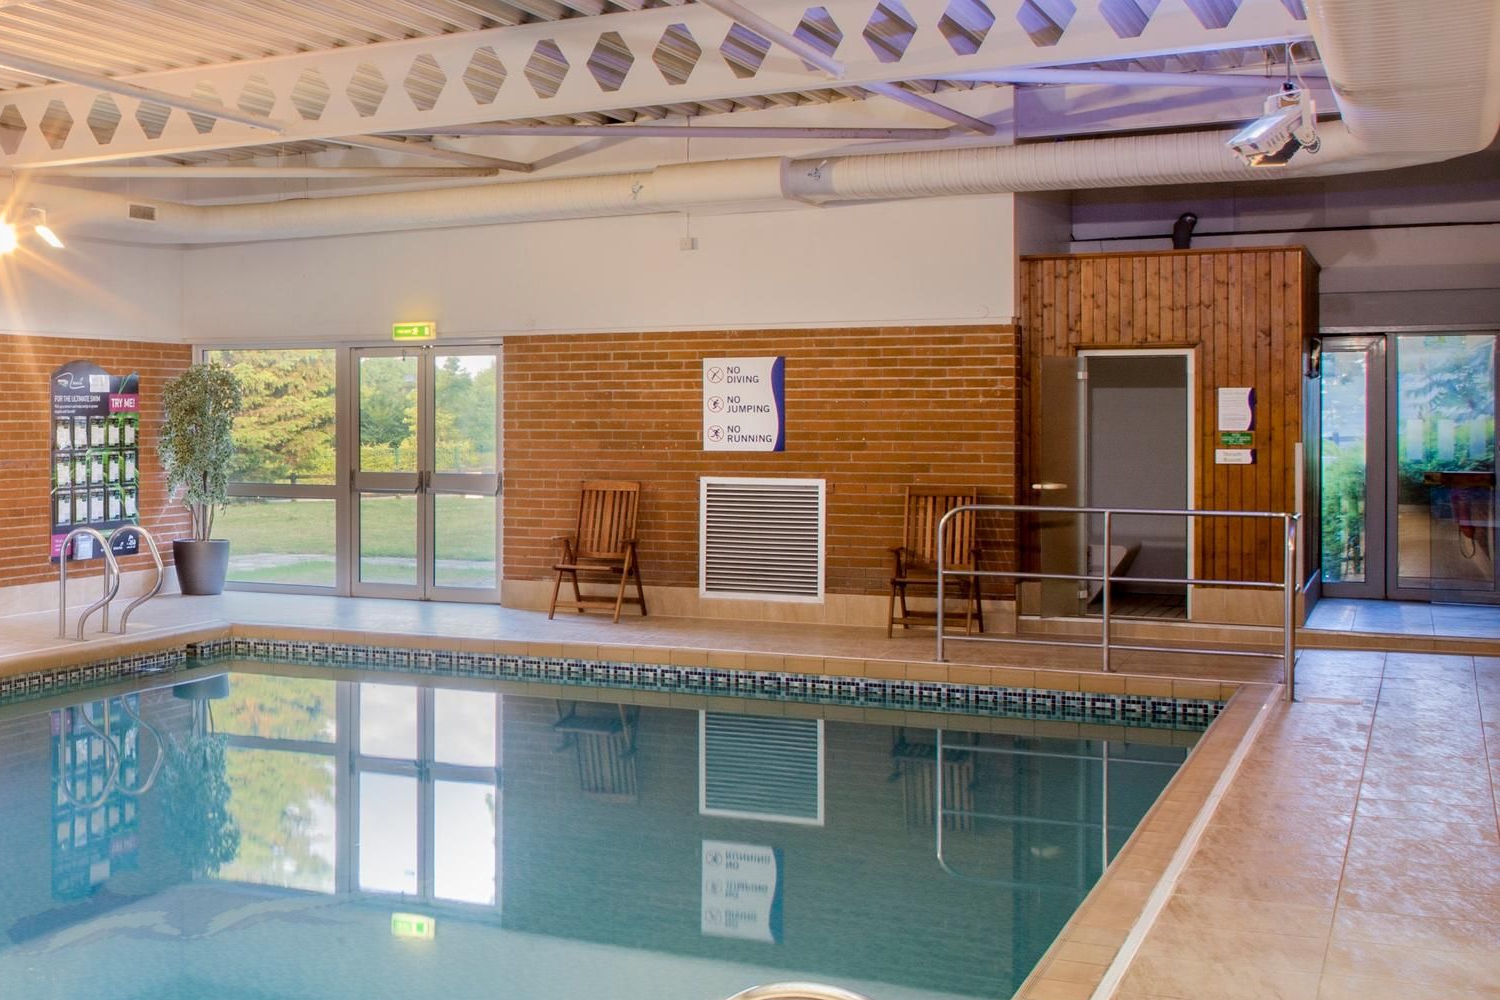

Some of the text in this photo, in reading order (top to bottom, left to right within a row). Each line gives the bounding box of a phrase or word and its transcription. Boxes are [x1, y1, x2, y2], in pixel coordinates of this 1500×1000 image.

[726, 366, 741, 375] NO
[726, 375, 760, 384] DIVING
[111, 398, 136, 408] TRY ME!
[726, 395, 741, 404] NO
[726, 405, 771, 413] JUMPING
[726, 425, 741, 433] NO
[726, 434, 773, 443] RUNNING
